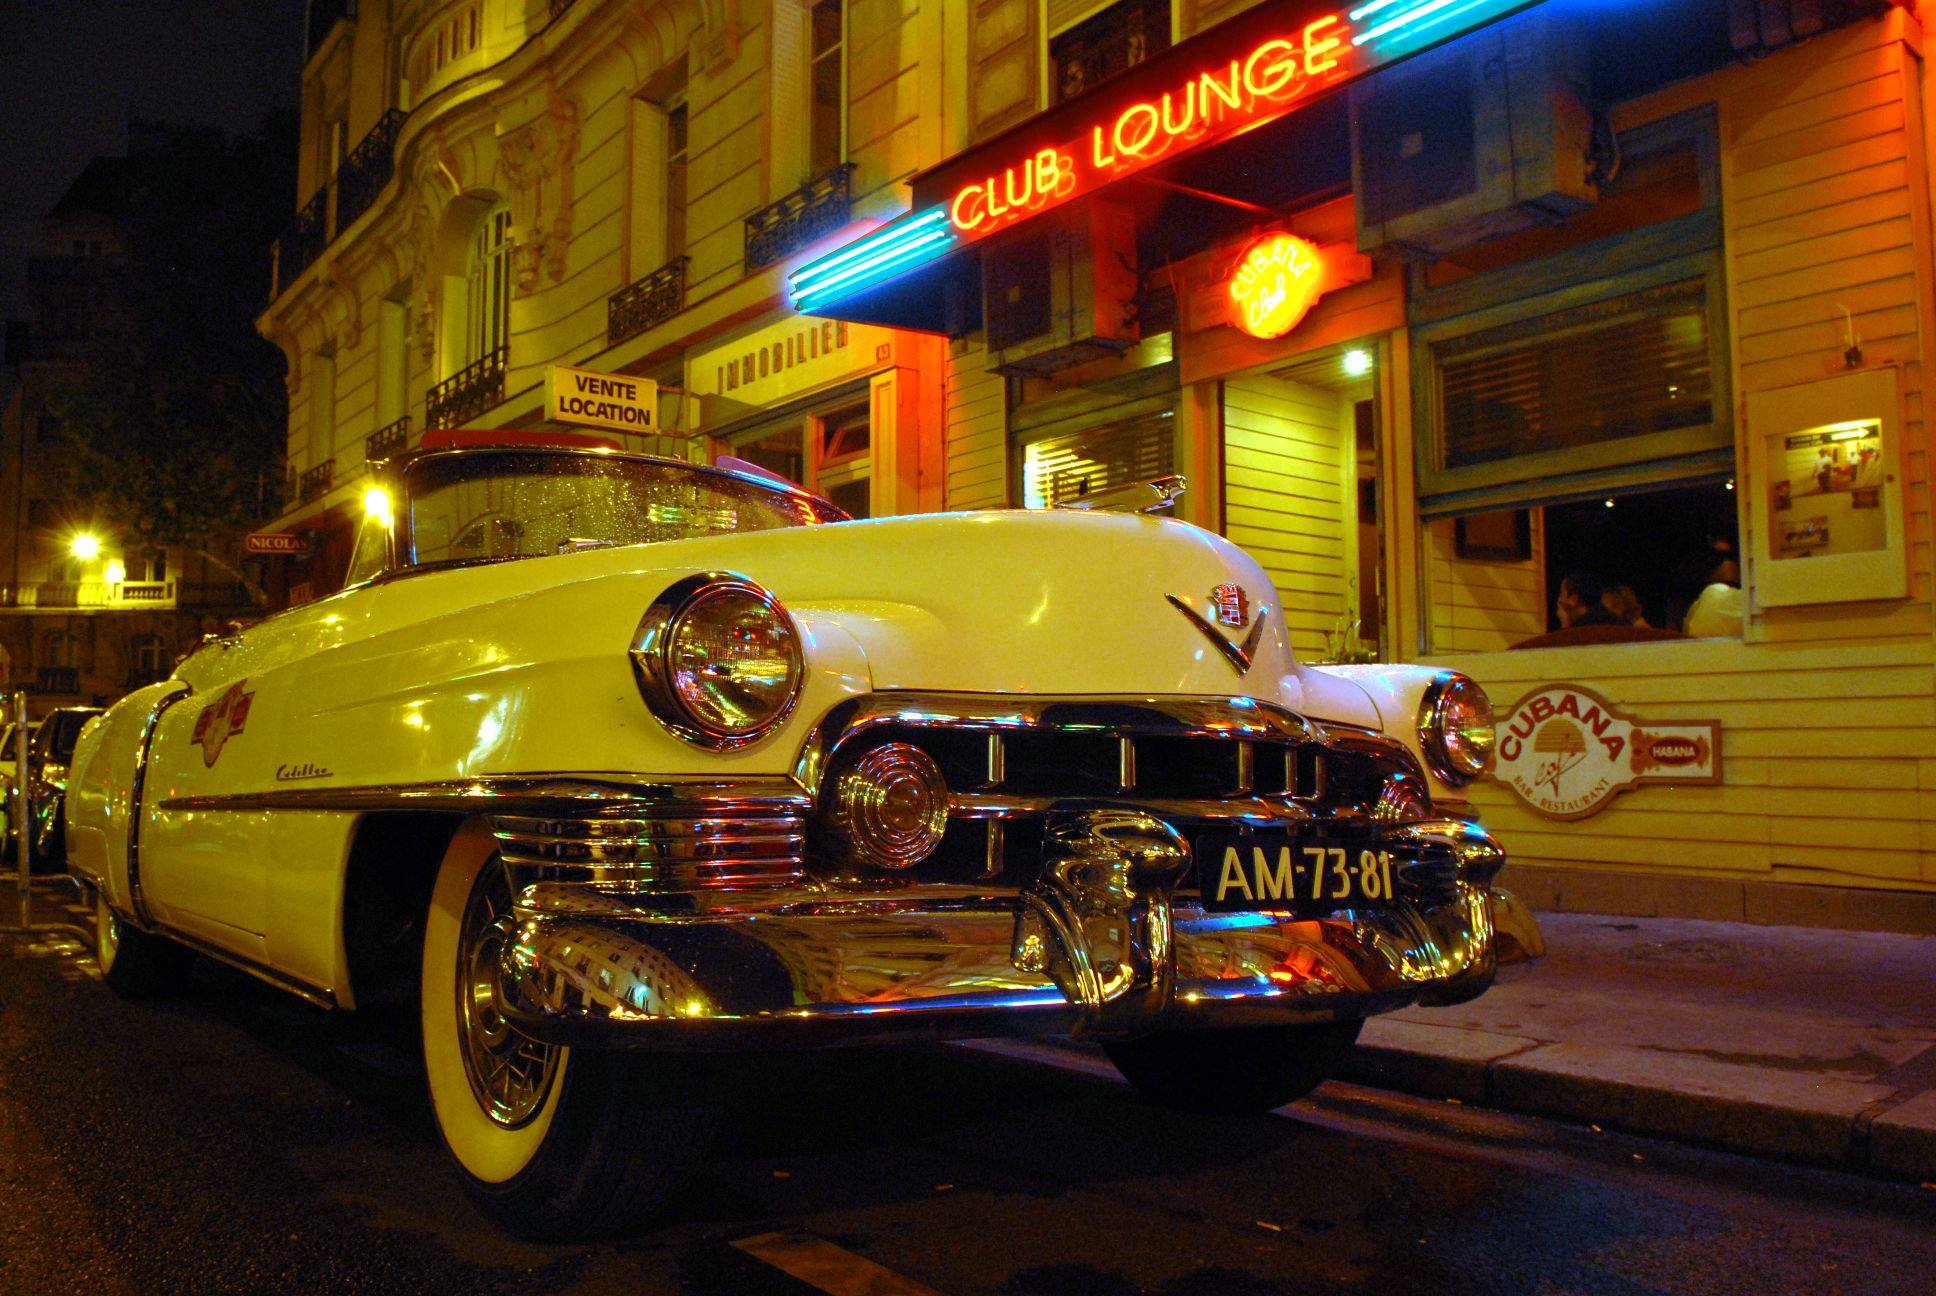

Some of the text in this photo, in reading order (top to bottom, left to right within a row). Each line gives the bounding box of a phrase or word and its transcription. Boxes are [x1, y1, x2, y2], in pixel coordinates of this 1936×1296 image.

[952, 15, 1340, 229] CLUB LOUNGE
[1230, 239, 1312, 299] CUBANA
[718, 320, 848, 395] IMMOBILIER
[560, 396, 651, 426] LOCATION
[575, 375, 637, 401] VENTE
[1500, 694, 1625, 762] CUBANA
[1653, 746, 1696, 757] HABANA
[1513, 775, 1609, 811] BAR RESTAURANT
[1217, 847, 1393, 901] AM-73-81
